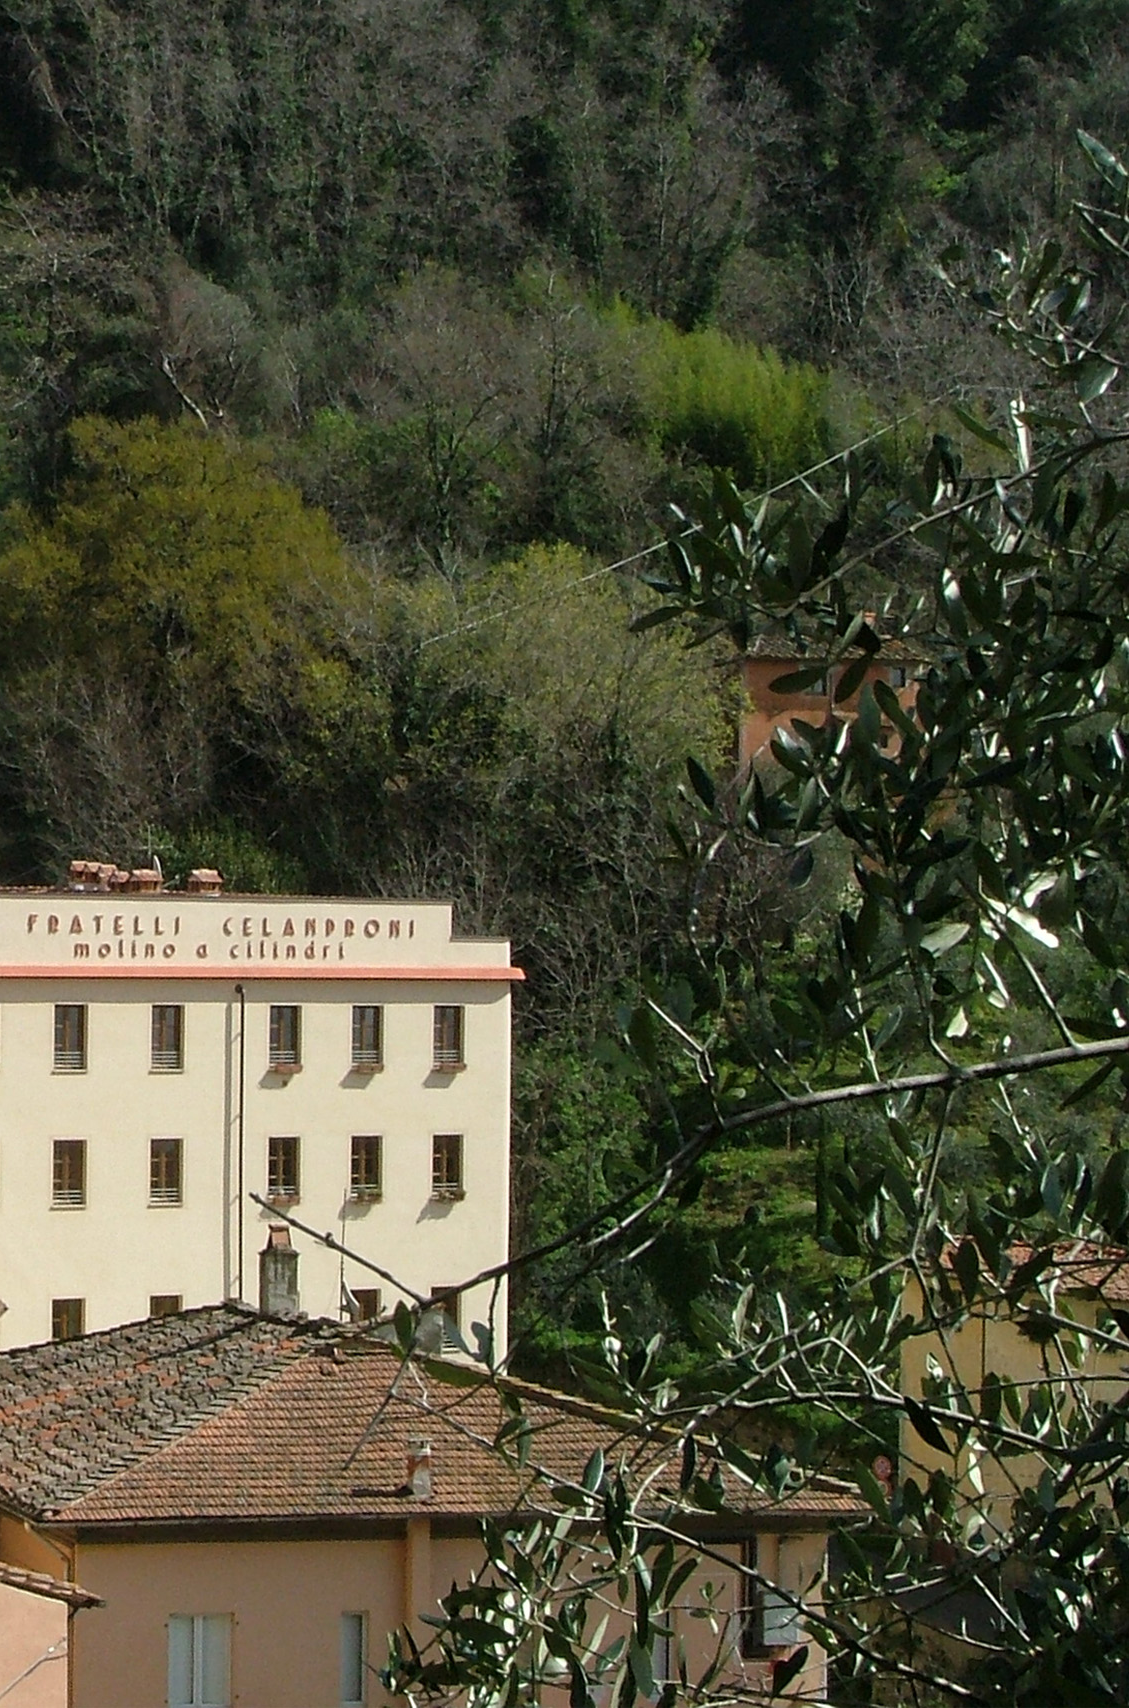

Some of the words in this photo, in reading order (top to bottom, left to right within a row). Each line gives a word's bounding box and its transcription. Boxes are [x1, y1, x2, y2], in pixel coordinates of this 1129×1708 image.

[26, 914, 181, 936] FRATELLI
[74, 939, 176, 959] molino
[196, 944, 208, 959] a
[229, 940, 345, 961] cilindri
